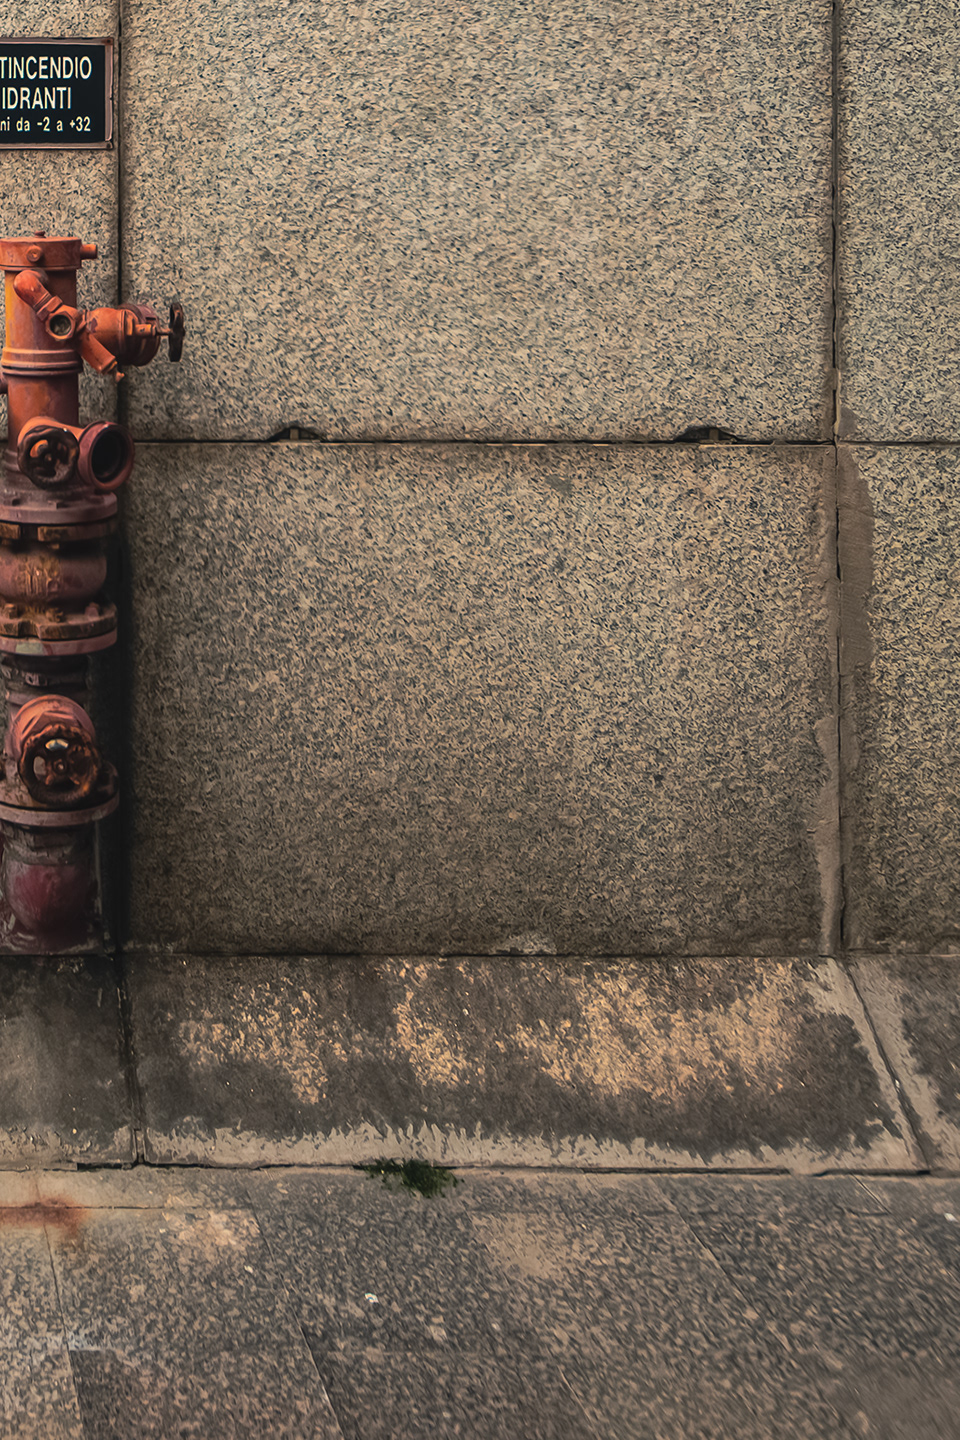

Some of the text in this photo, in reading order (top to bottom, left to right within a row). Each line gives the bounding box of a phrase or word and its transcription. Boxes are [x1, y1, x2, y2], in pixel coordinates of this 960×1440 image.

[2, 86, 72, 110] IDRANTI
[15, 116, 31, 132] da
[36, 116, 51, 132] -2
[56, 119, 64, 132] a
[69, 115, 91, 132] +32
